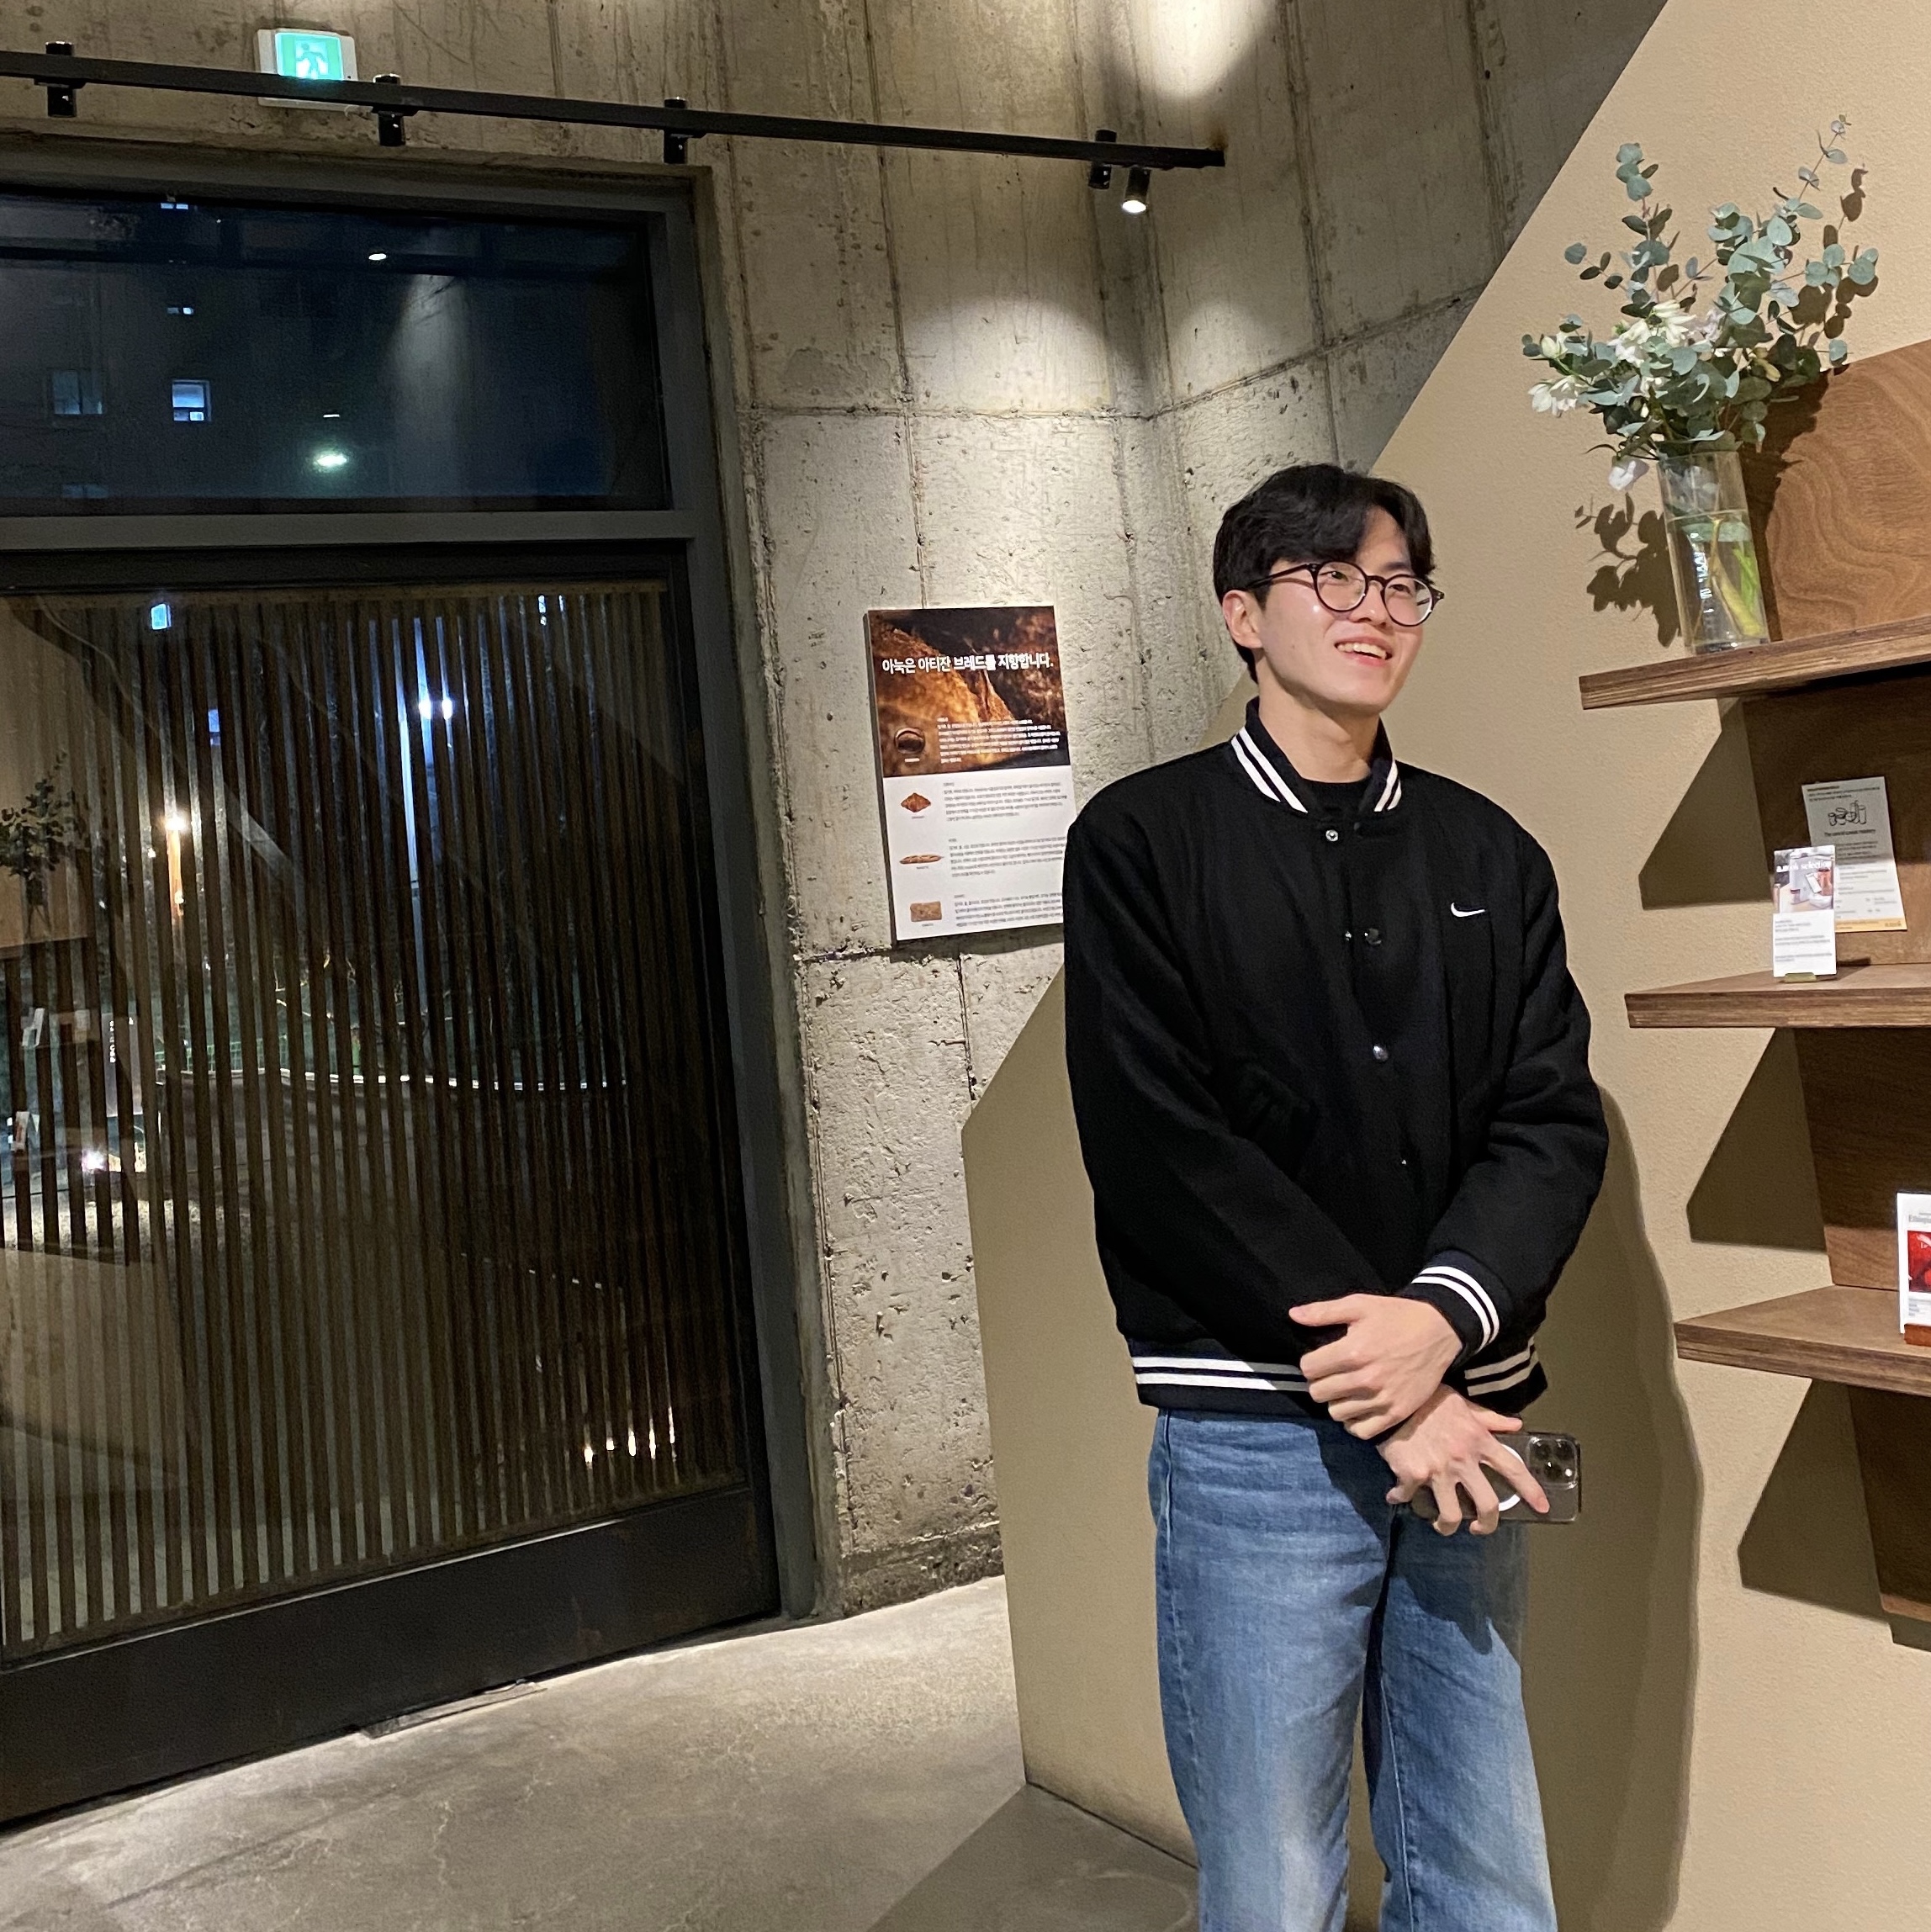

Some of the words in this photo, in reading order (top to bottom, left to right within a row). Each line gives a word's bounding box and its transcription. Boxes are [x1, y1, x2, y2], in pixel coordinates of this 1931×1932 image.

[882, 657, 916, 674] 아눅은
[918, 655, 951, 672] 아티잔
[953, 654, 997, 671] 브레드를
[997, 652, 1055, 670] 지향합니다.
